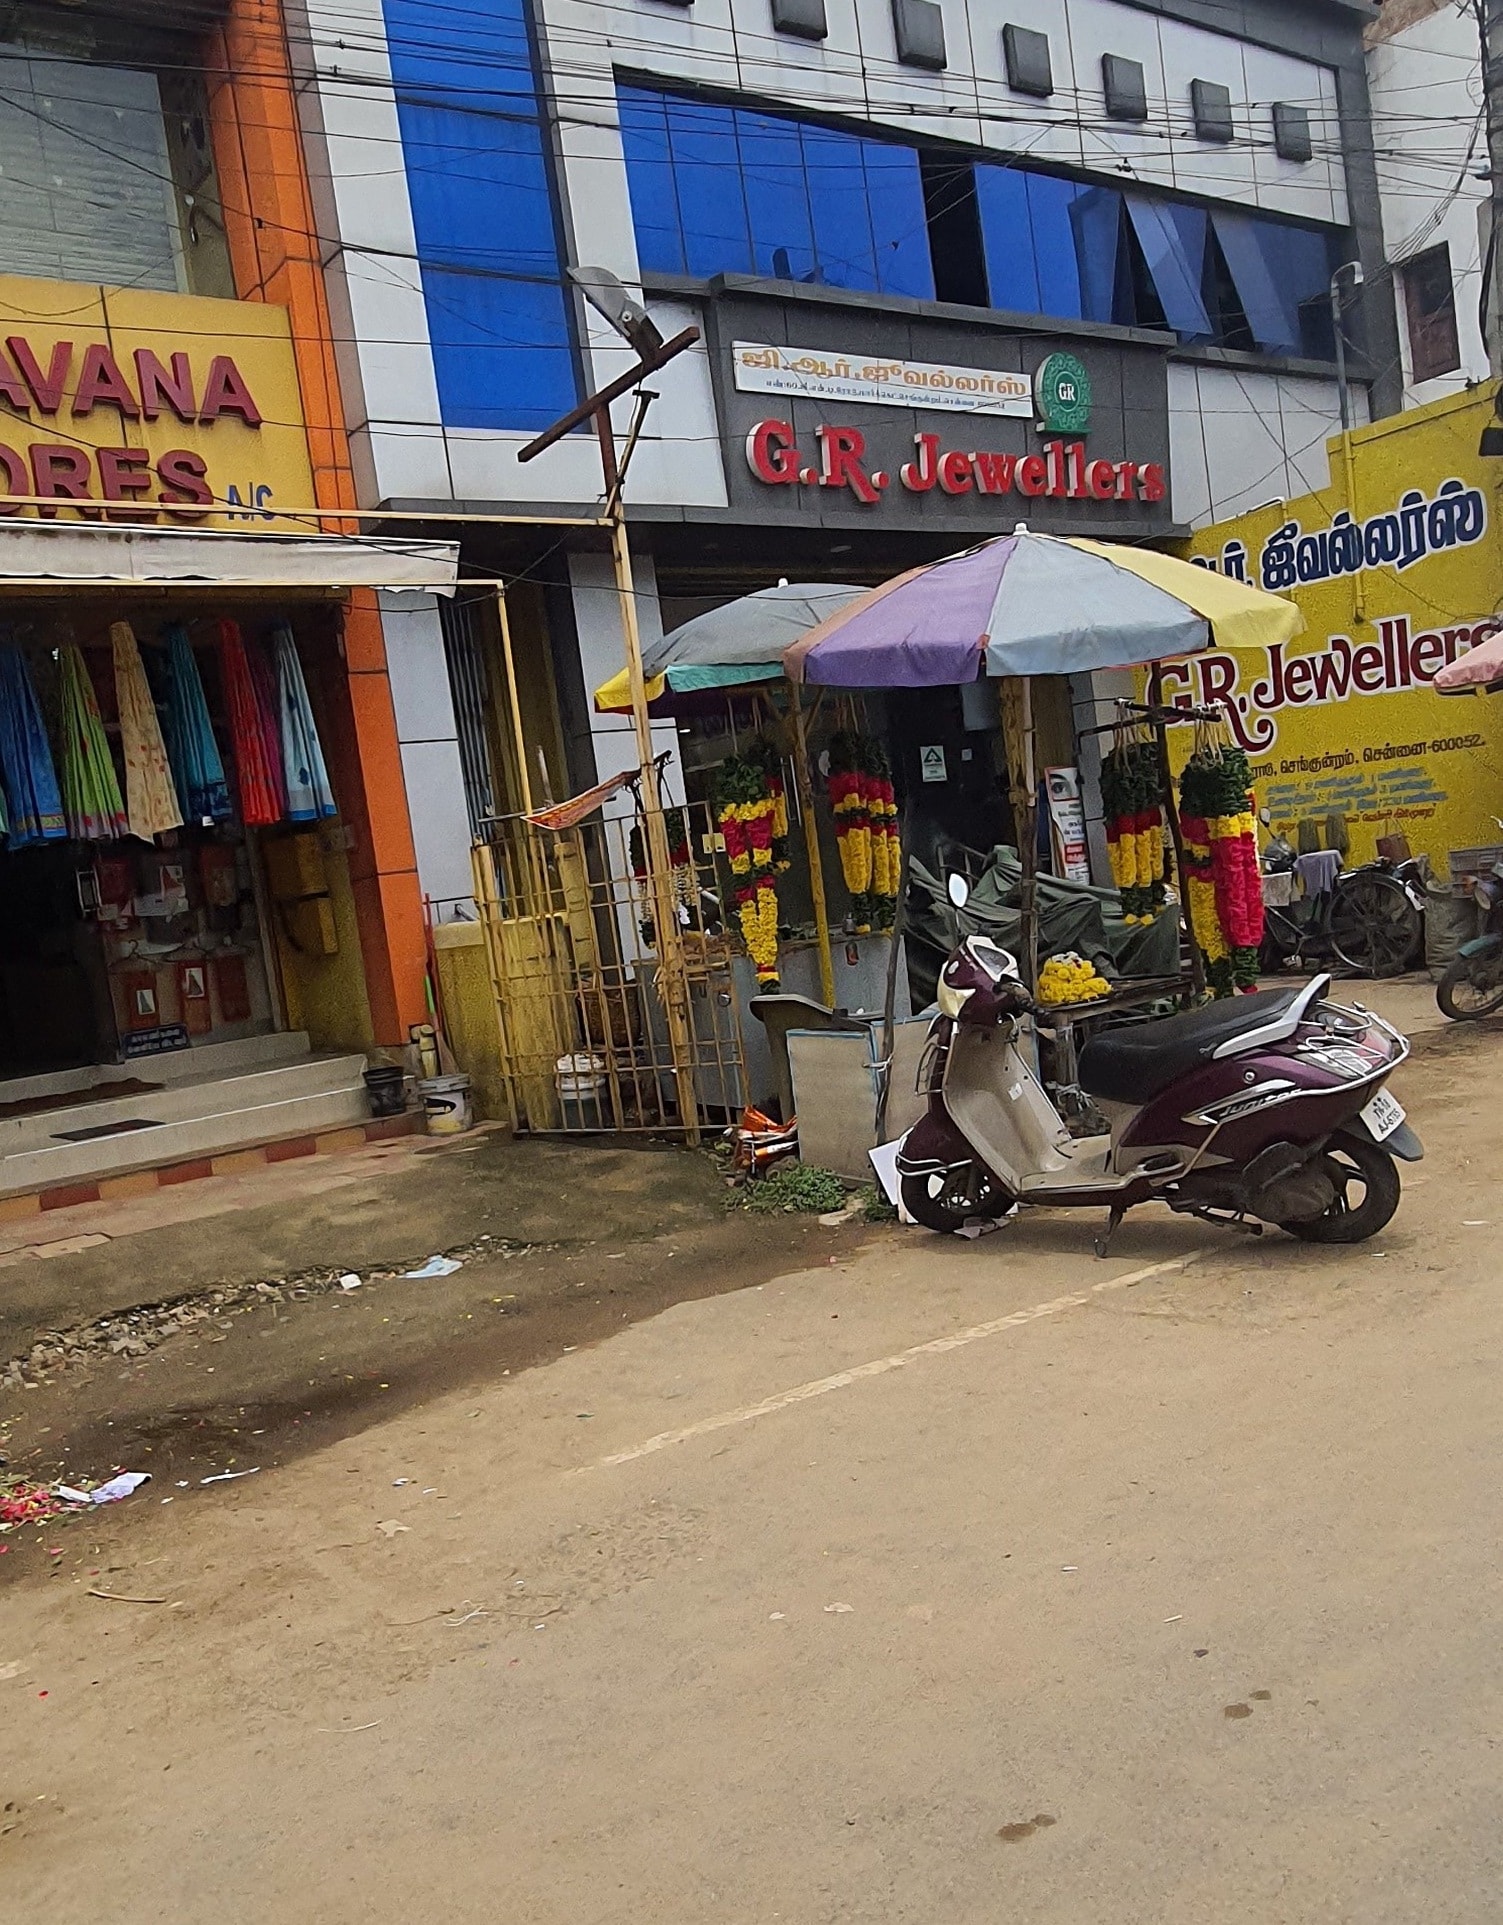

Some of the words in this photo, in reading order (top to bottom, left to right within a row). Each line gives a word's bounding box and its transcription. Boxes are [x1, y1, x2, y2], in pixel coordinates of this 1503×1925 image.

[1058, 382, 1076, 401] GR
[746, 418, 890, 503] G.R.
[900, 432, 1166, 502] Jewellers
